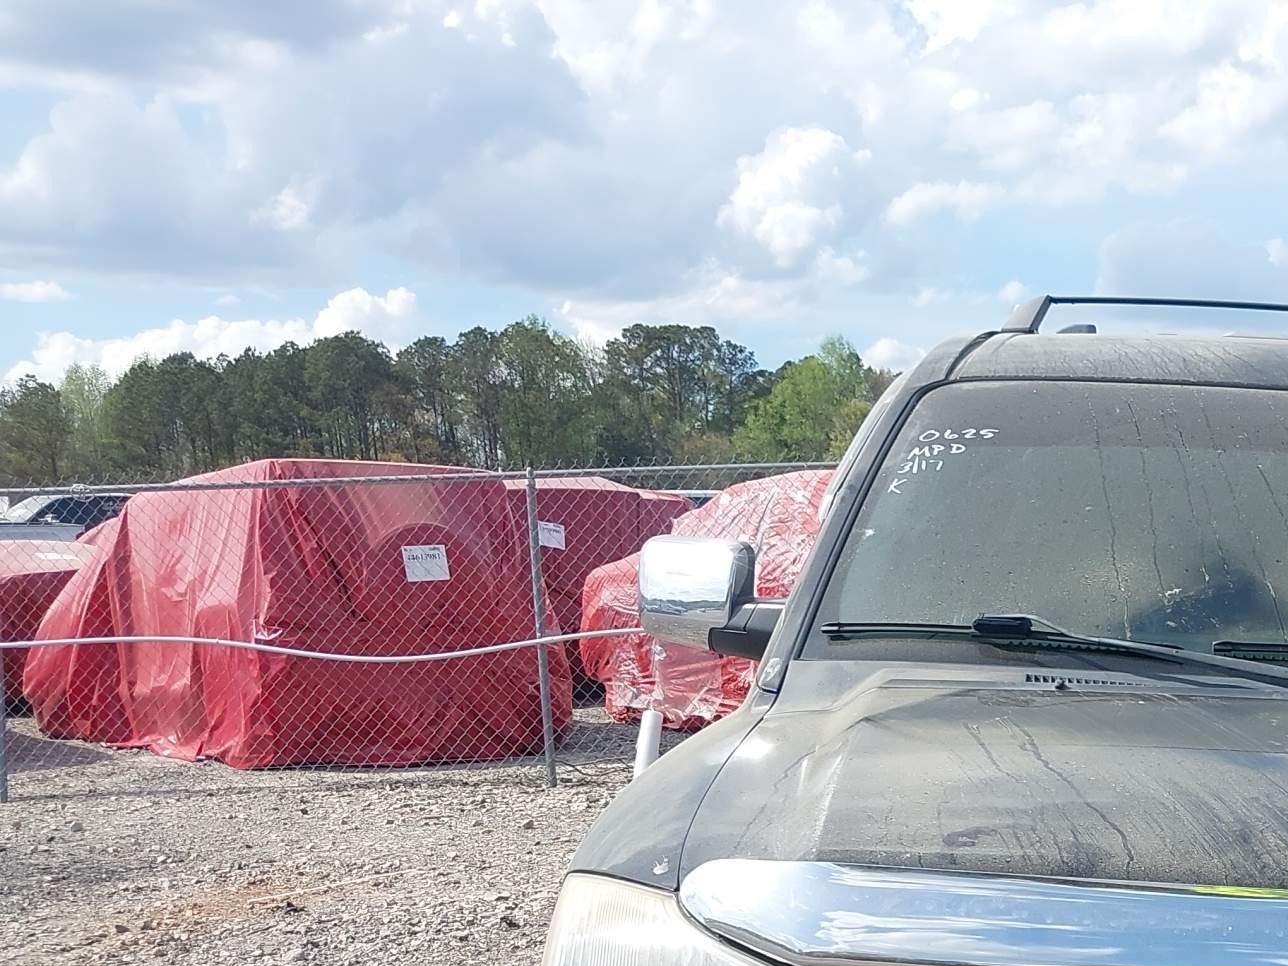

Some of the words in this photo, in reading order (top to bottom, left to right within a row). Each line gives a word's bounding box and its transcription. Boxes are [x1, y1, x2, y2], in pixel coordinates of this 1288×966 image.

[919, 428, 1000, 442] 0625
[897, 456, 944, 474] 3/17
[887, 478, 908, 494] K
